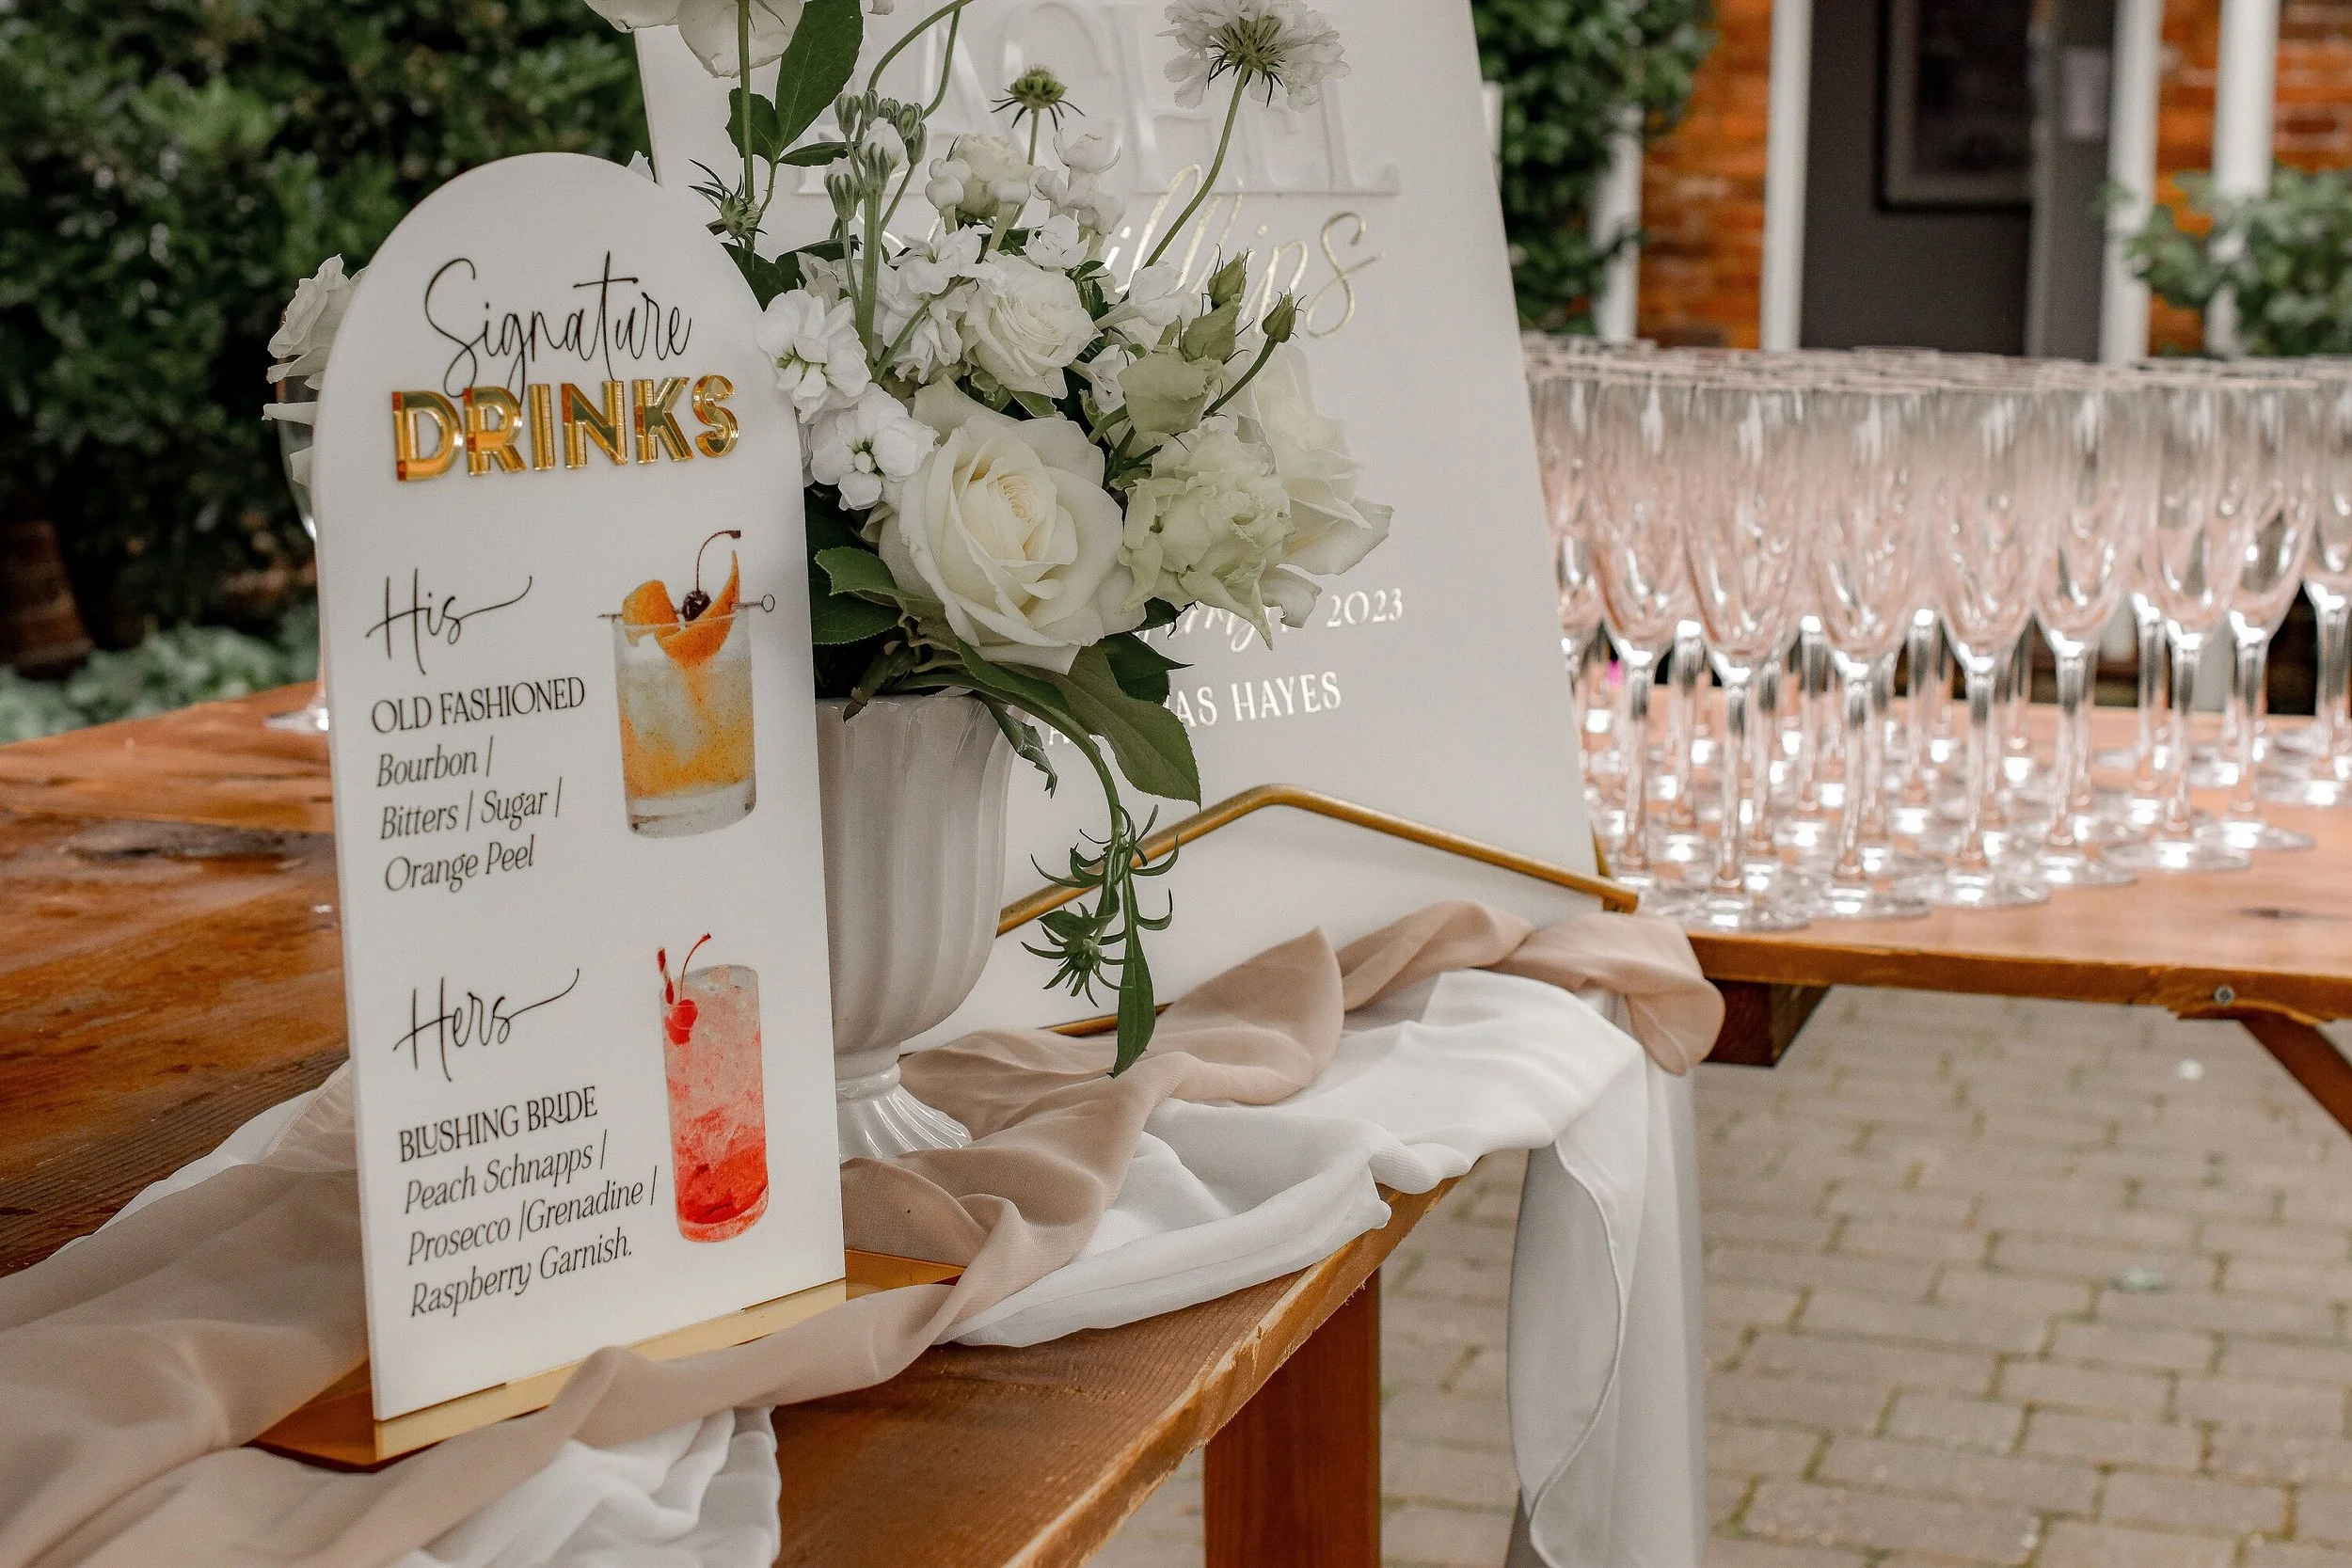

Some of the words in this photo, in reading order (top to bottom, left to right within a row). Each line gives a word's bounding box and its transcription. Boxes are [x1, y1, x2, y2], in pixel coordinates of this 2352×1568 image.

[425, 250, 692, 405] Signature
[391, 374, 739, 482] DRINKS
[366, 567, 532, 675] His
[1326, 587, 1405, 628] 2023
[372, 693, 432, 734] OLD
[439, 676, 586, 726] FASHIONED
[1231, 670, 1343, 722] HAYES
[377, 743, 477, 787] Bourbon
[380, 804, 458, 840] Bitters
[481, 789, 548, 831] Sugar
[384, 852, 479, 893] Orange
[485, 834, 535, 875] Peel
[393, 968, 580, 1082] Hers
[399, 1103, 519, 1163] BLUSHING
[527, 1085, 598, 1132] BRIDE
[405, 1164, 476, 1214] Peach
[483, 1144, 593, 1194] Schnapps
[407, 1217, 511, 1266] Prosecco
[410, 1265, 532, 1318] Raspberry
[540, 1227, 632, 1279] Garnish.
